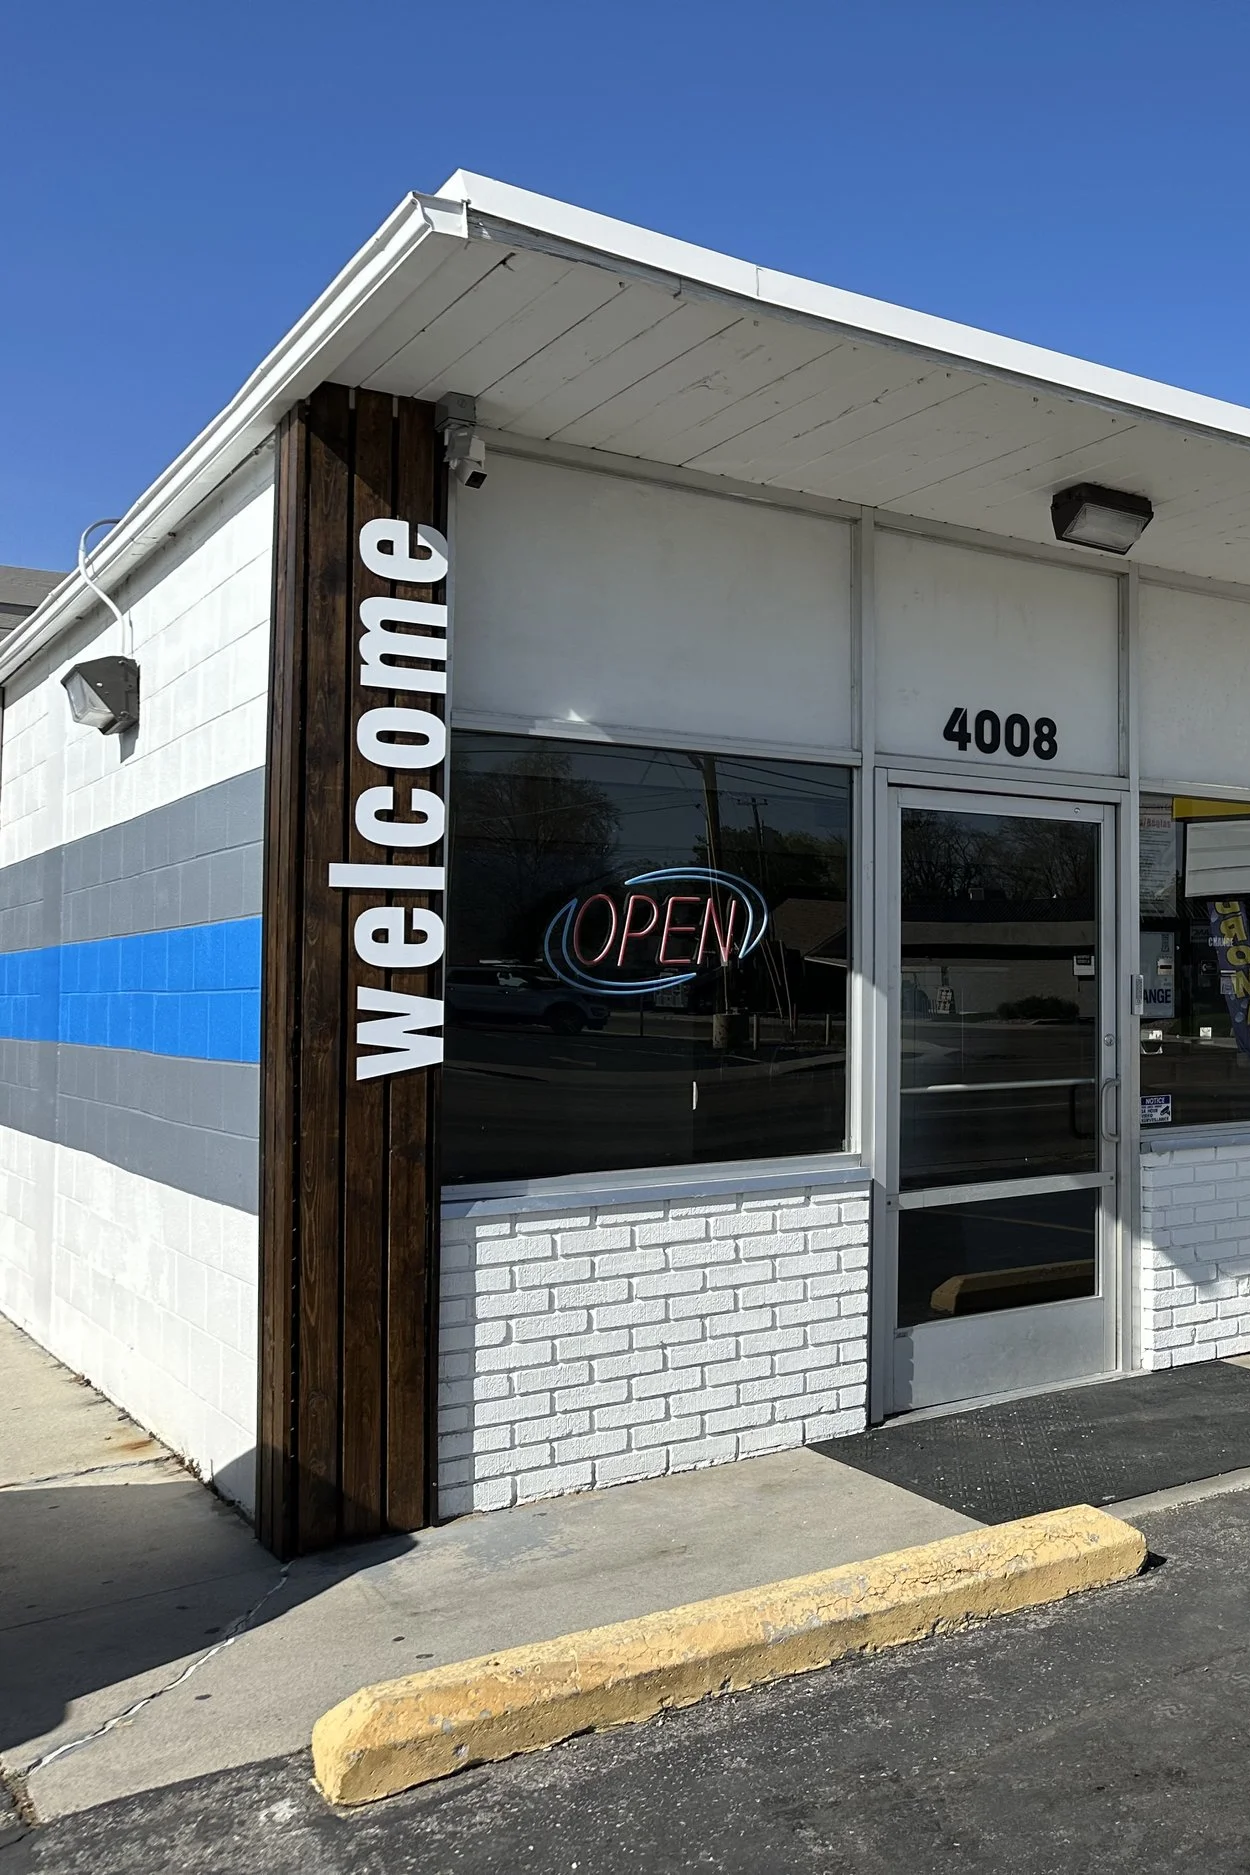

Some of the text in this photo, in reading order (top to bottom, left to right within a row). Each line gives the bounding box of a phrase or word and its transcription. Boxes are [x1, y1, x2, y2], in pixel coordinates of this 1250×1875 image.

[943, 707, 1058, 761] 4008
[328, 517, 449, 1081] welcome
[574, 893, 737, 967] OPEN
[1143, 989, 1172, 1004] ANGE
